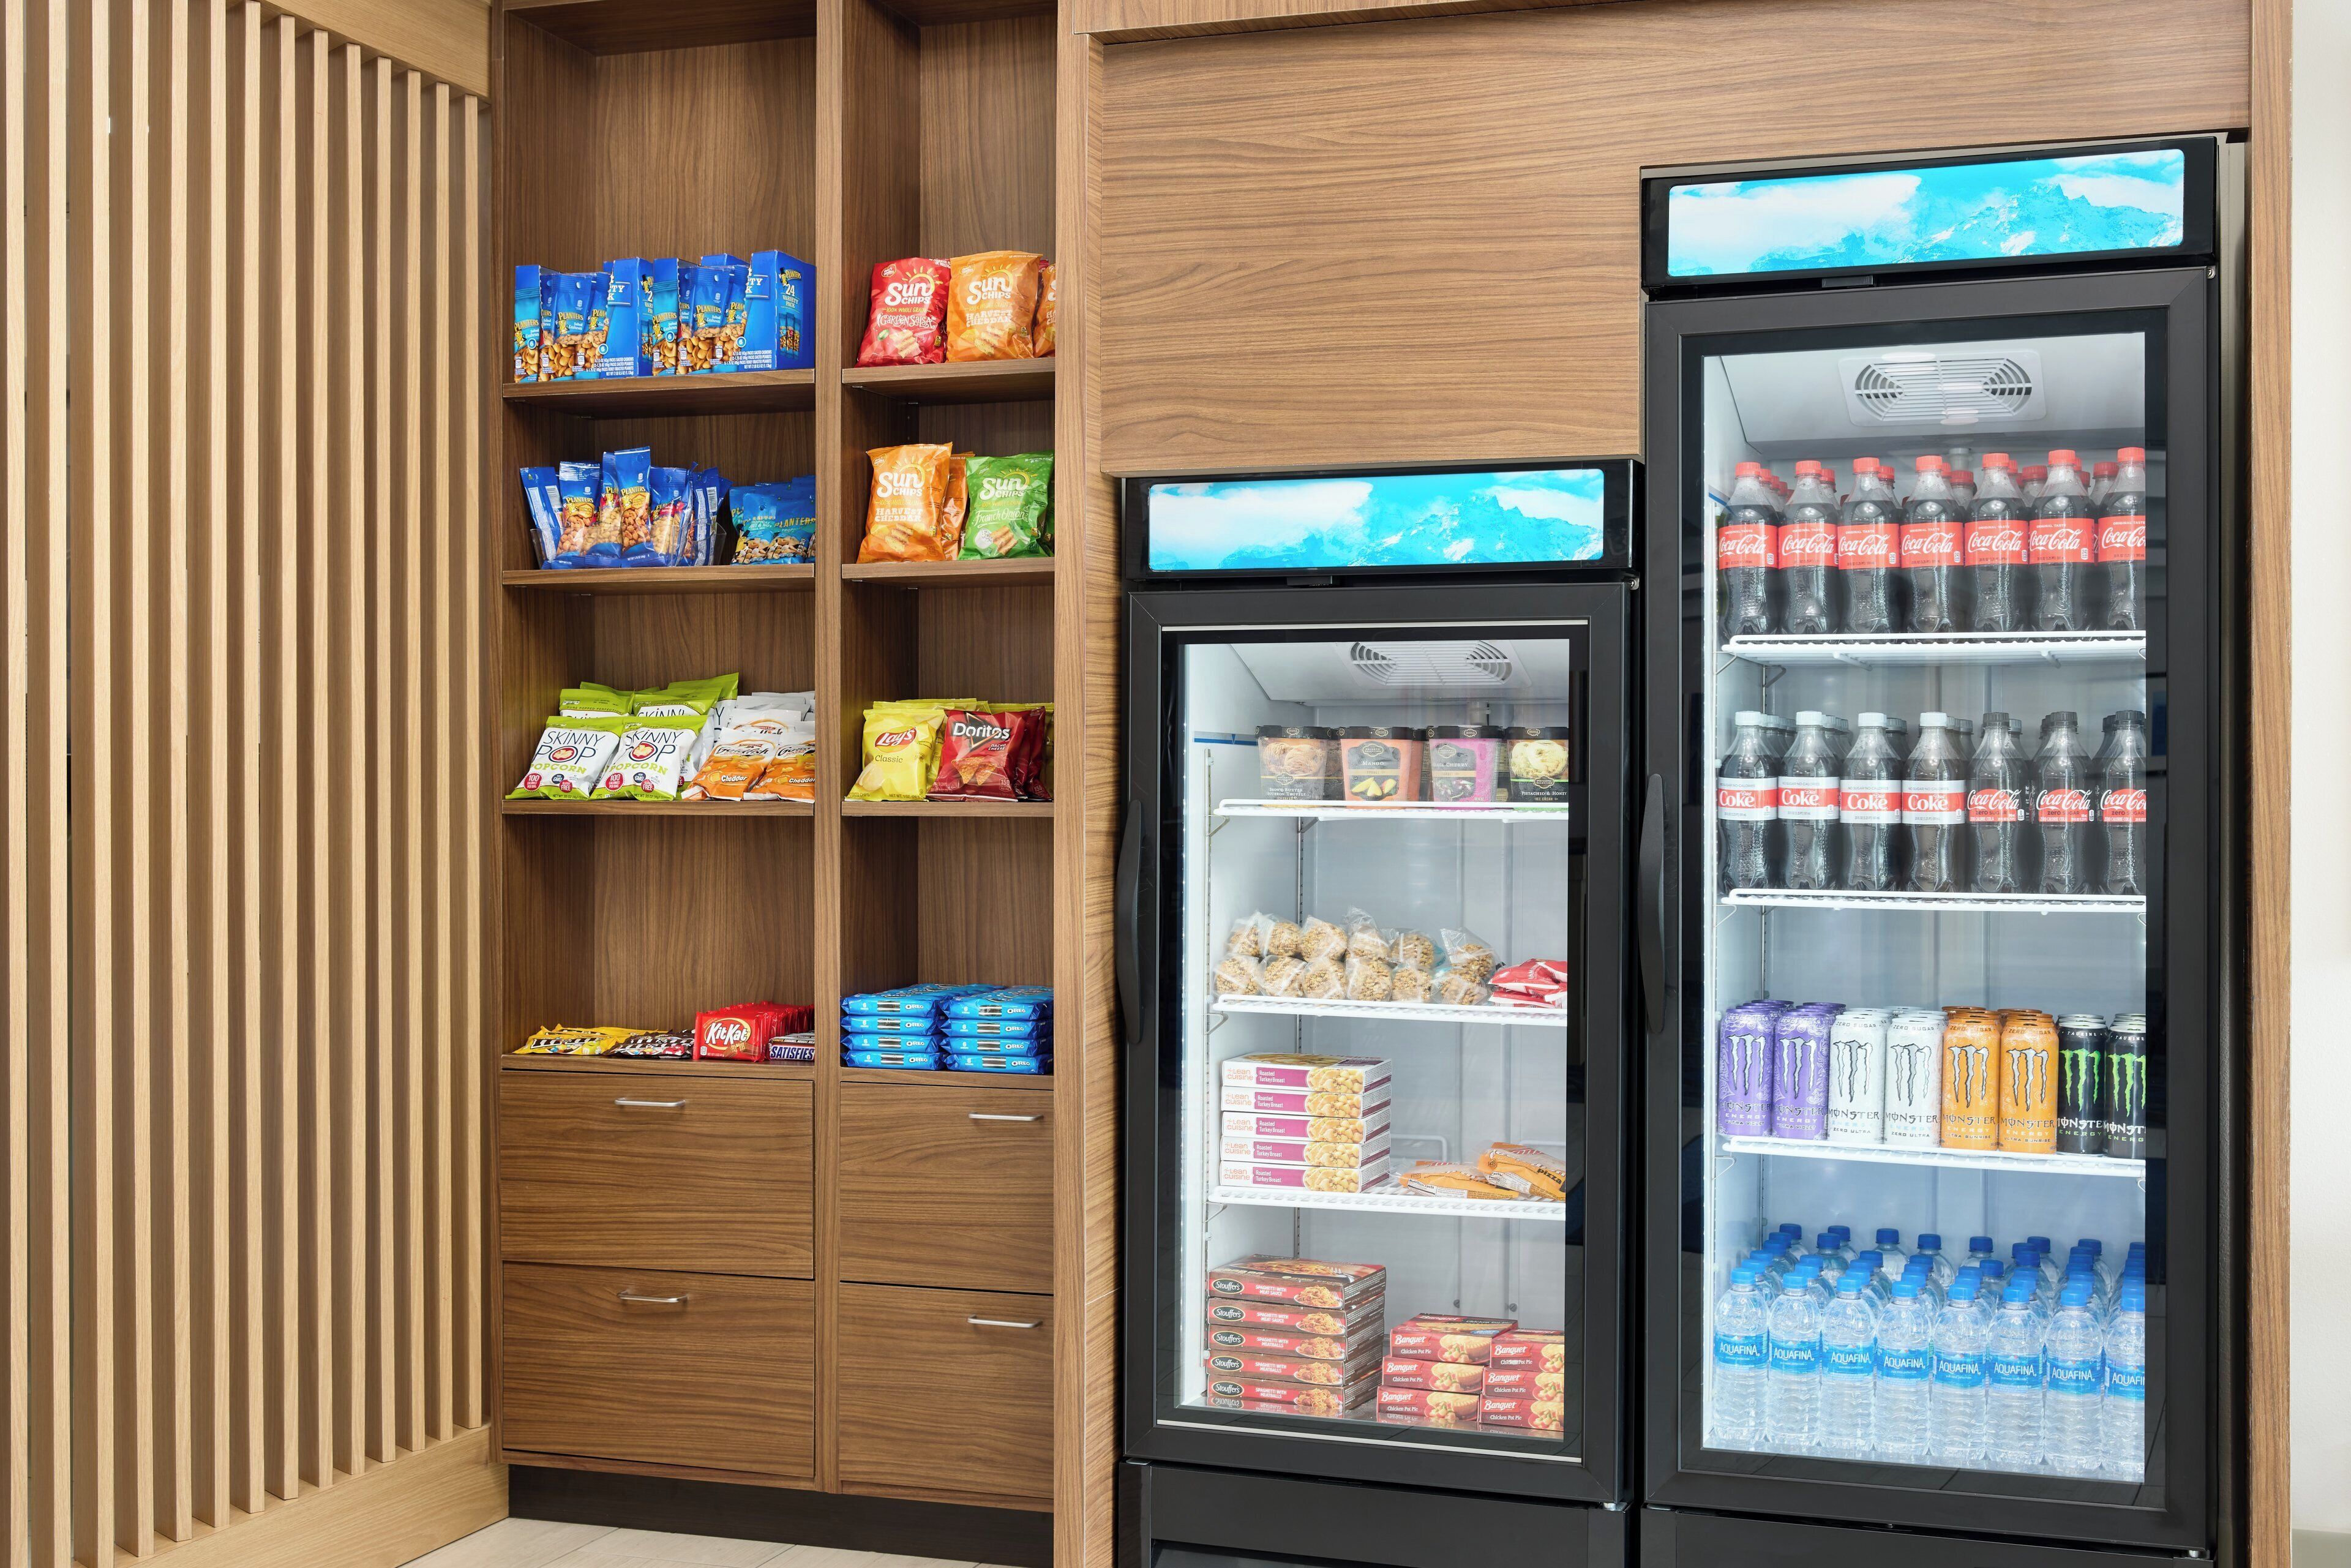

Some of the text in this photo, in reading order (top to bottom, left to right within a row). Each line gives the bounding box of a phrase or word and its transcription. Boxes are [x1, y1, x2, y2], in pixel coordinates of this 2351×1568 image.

[786, 270, 801, 279] PLANTERS
[786, 284, 795, 296] 24
[885, 282, 933, 306] Sun
[967, 277, 1013, 304] Sun
[782, 295, 798, 304] VARIETY
[653, 312, 677, 324] PLANTERS
[514, 320, 539, 331] PLANTERS
[621, 487, 646, 495] PLANTERS
[877, 471, 924, 498] Sun
[980, 478, 1029, 500] Sun
[893, 488, 923, 497] CHIPS
[974, 508, 1027, 527] French Onion
[1719, 535, 1769, 557] Coca-Cola
[1782, 534, 1835, 555] Coca-Cola
[1839, 535, 1891, 556] Coca-Cola
[1902, 533, 1955, 555] Coca-Cola
[1968, 530, 2023, 553] Coca-Cola
[2030, 529, 2083, 551] Coca-Cola
[877, 729, 915, 746] Lay's
[953, 722, 1010, 740] Doritos
[532, 745, 596, 765] POP
[610, 763, 668, 775] POPCORN
[1720, 791, 1755, 807] Coke
[1782, 790, 1820, 806] Coke
[1848, 794, 1888, 809] Coke
[1908, 795, 1948, 810] Coke
[1967, 789, 2022, 810] Coca-Cola
[2036, 790, 2092, 810] Coca-Cola
[771, 1046, 814, 1060] SATISFIES
[1828, 1108, 1879, 1120] MONSTER
[1886, 1112, 1938, 1124] MONSTER
[1943, 1114, 1995, 1125] MONSTER
[2001, 1117, 2054, 1128] MONSTER
[1537, 1168, 1562, 1185] pizza
[1215, 1281, 1240, 1291] Stouffer's
[1217, 1308, 1241, 1318] Stouffer's
[1217, 1334, 1241, 1343] Stouffer's
[1395, 1335, 1427, 1345] Banquet
[1494, 1345, 1528, 1355] Banquet
[1720, 1341, 1758, 1356] AQUAFINA
[1774, 1348, 1812, 1360] AQUAFINA
[1215, 1359, 1239, 1368] Stouffer's
[1831, 1352, 1870, 1365] AQUAFINA
[1884, 1356, 1924, 1369] AQUAFINA
[1387, 1363, 1419, 1373] Banquet
[1939, 1360, 1979, 1373] AQUAFINA
[1995, 1362, 2034, 1375] AQUAFINA
[1488, 1373, 1521, 1383] Banquet
[2052, 1367, 2093, 1381] AQUAFINA
[1215, 1384, 1240, 1394] Stouffer's
[1381, 1392, 1413, 1402] Banquet
[1484, 1400, 1517, 1410] Banquet
